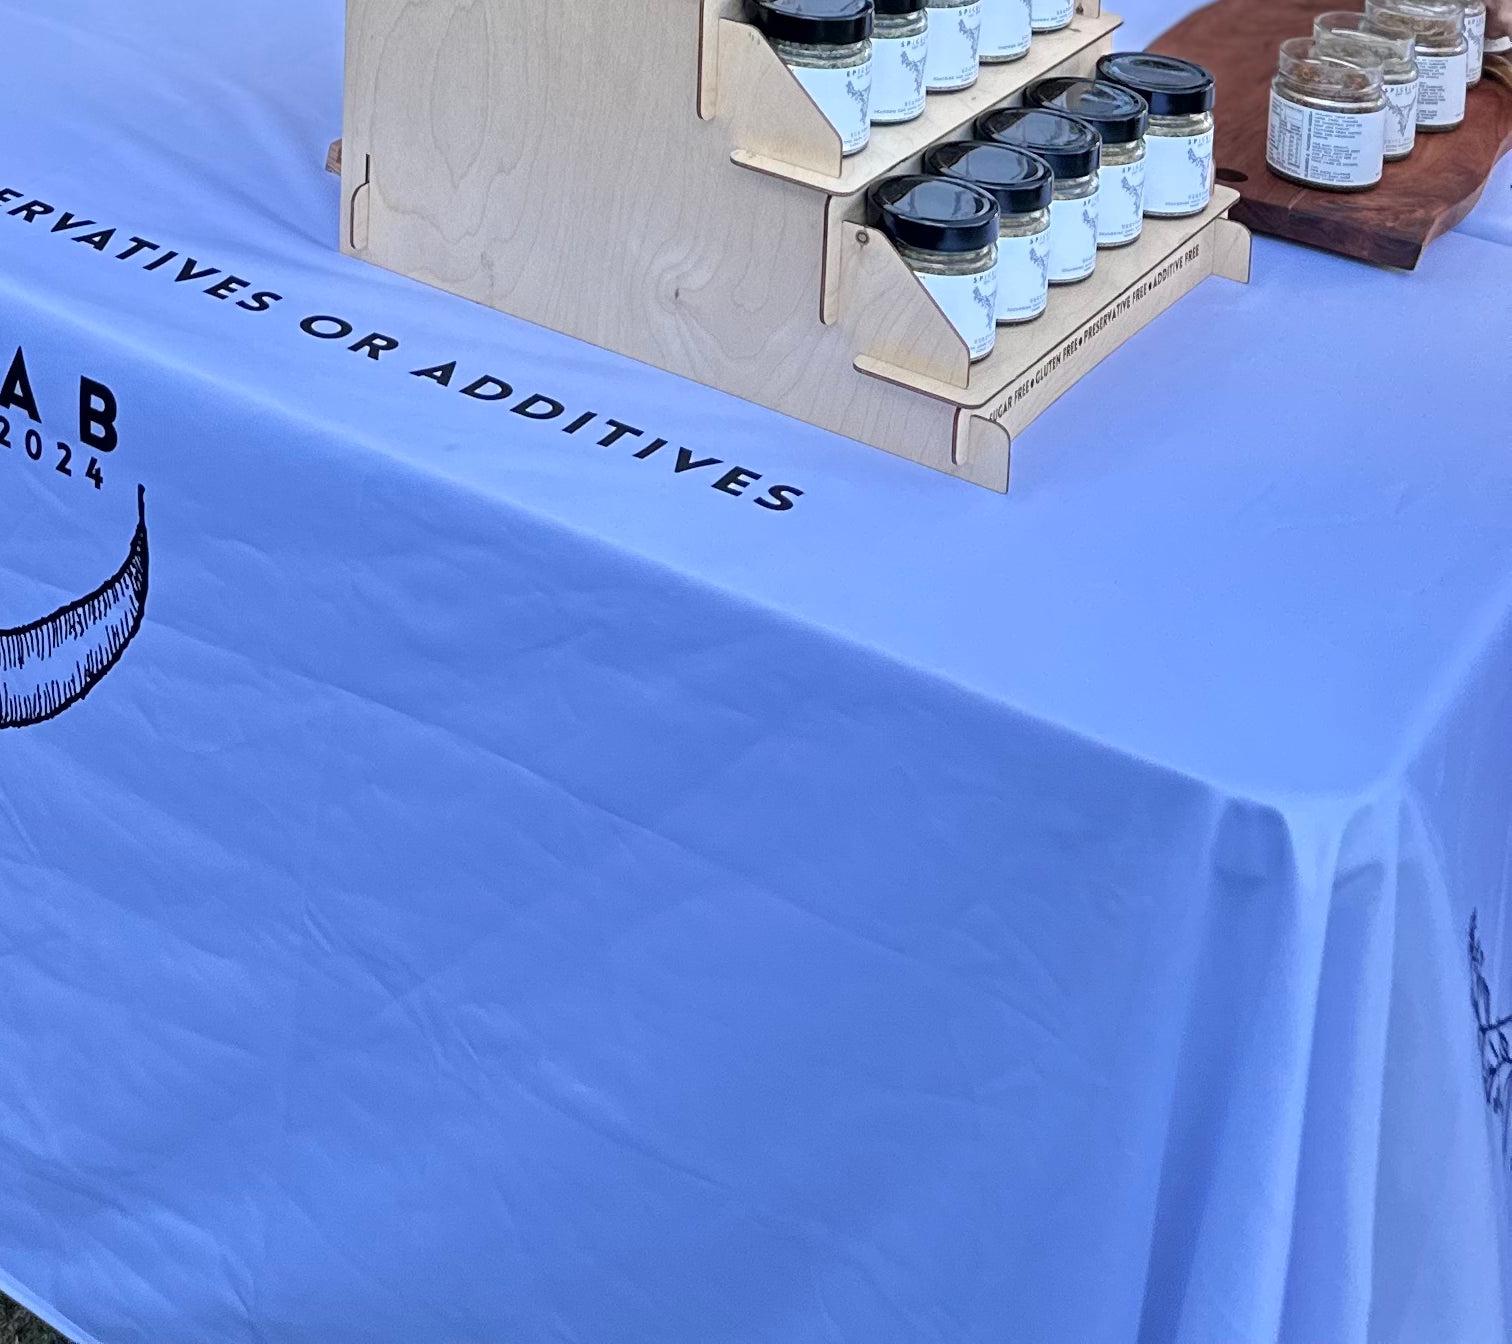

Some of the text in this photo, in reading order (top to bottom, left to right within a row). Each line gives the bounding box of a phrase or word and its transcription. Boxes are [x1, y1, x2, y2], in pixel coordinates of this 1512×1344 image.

[300, 314, 400, 361] OR
[410, 359, 807, 512] ADDITIVES
[1014, 380, 1030, 405] FREE
[1035, 352, 1062, 385] GLUTEN
[1062, 337, 1078, 362] FREE
[1083, 295, 1131, 343] PRESERVATIVE
[1132, 282, 1147, 306] FREE
[1152, 255, 1184, 288] ADDITIVE
[1184, 244, 1200, 266] FREE
